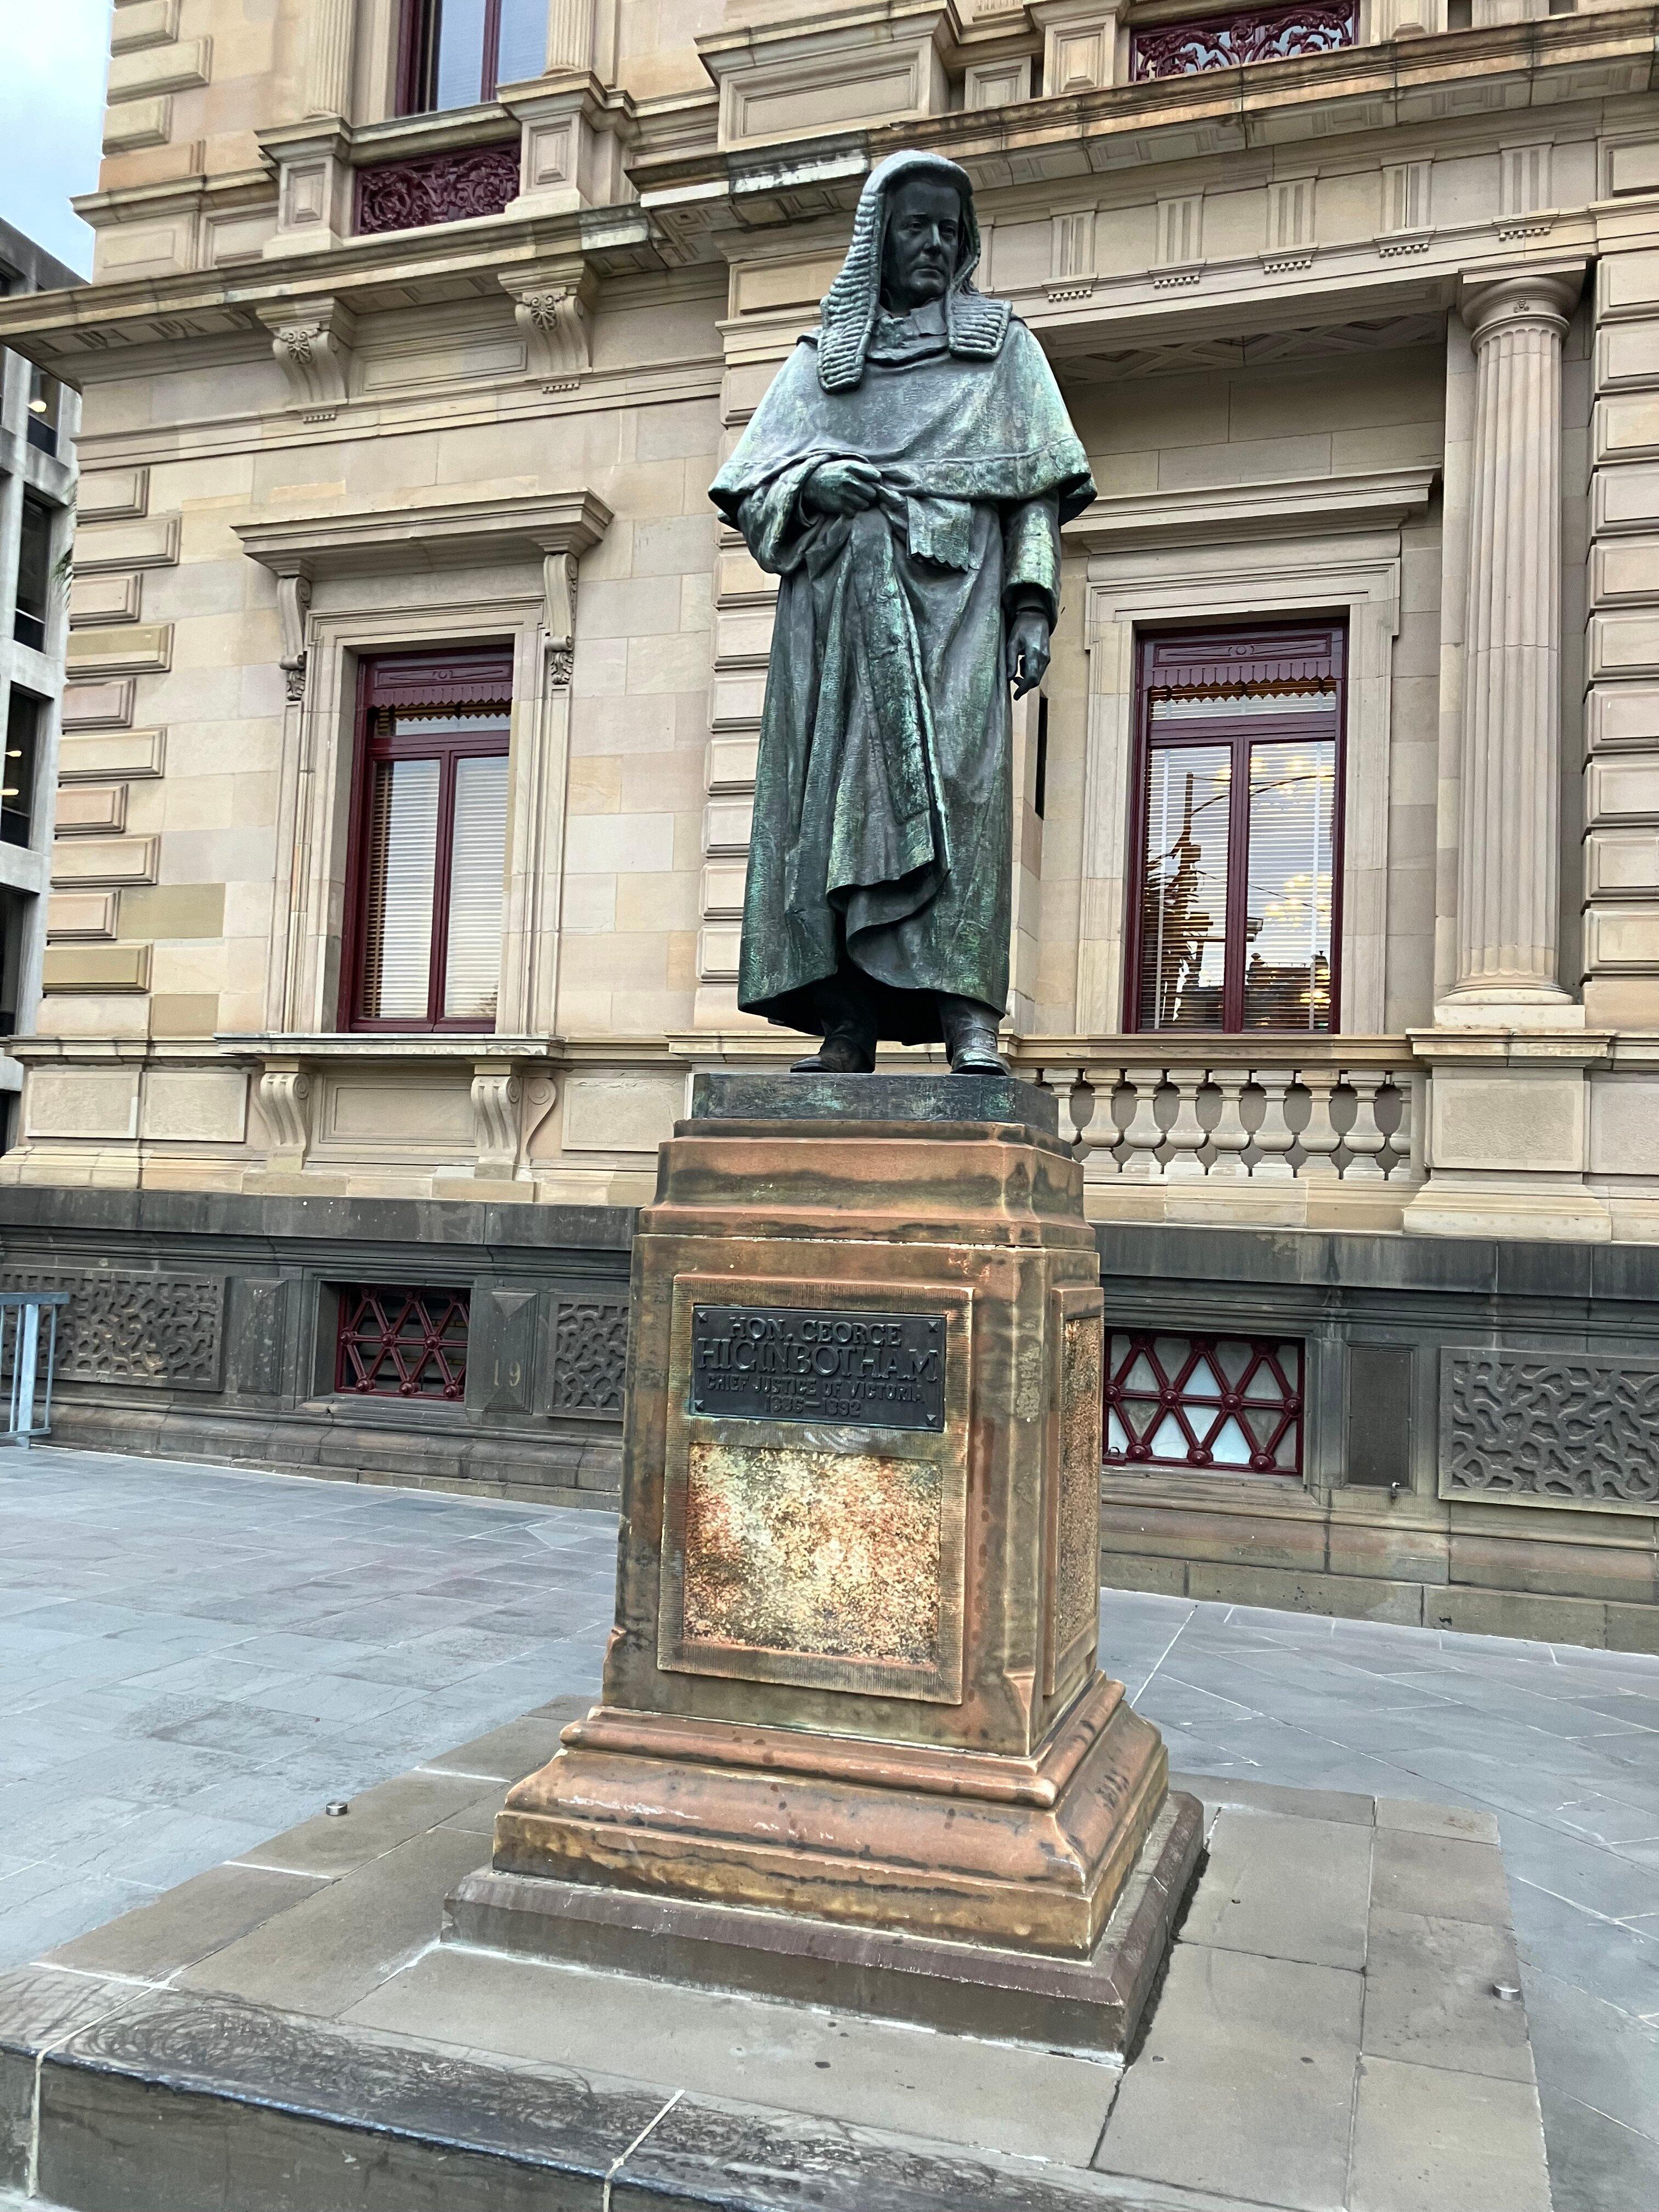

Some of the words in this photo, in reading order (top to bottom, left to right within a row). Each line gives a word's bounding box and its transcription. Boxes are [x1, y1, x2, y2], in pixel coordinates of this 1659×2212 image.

[729, 1317, 794, 1340] HON.
[801, 1319, 902, 1346] GEORGE
[697, 1338, 938, 1382] HIGINBOTHAM
[707, 1374, 749, 1391] CHIEF
[754, 1376, 817, 1395] JUSTICE
[823, 1381, 842, 1397] OF
